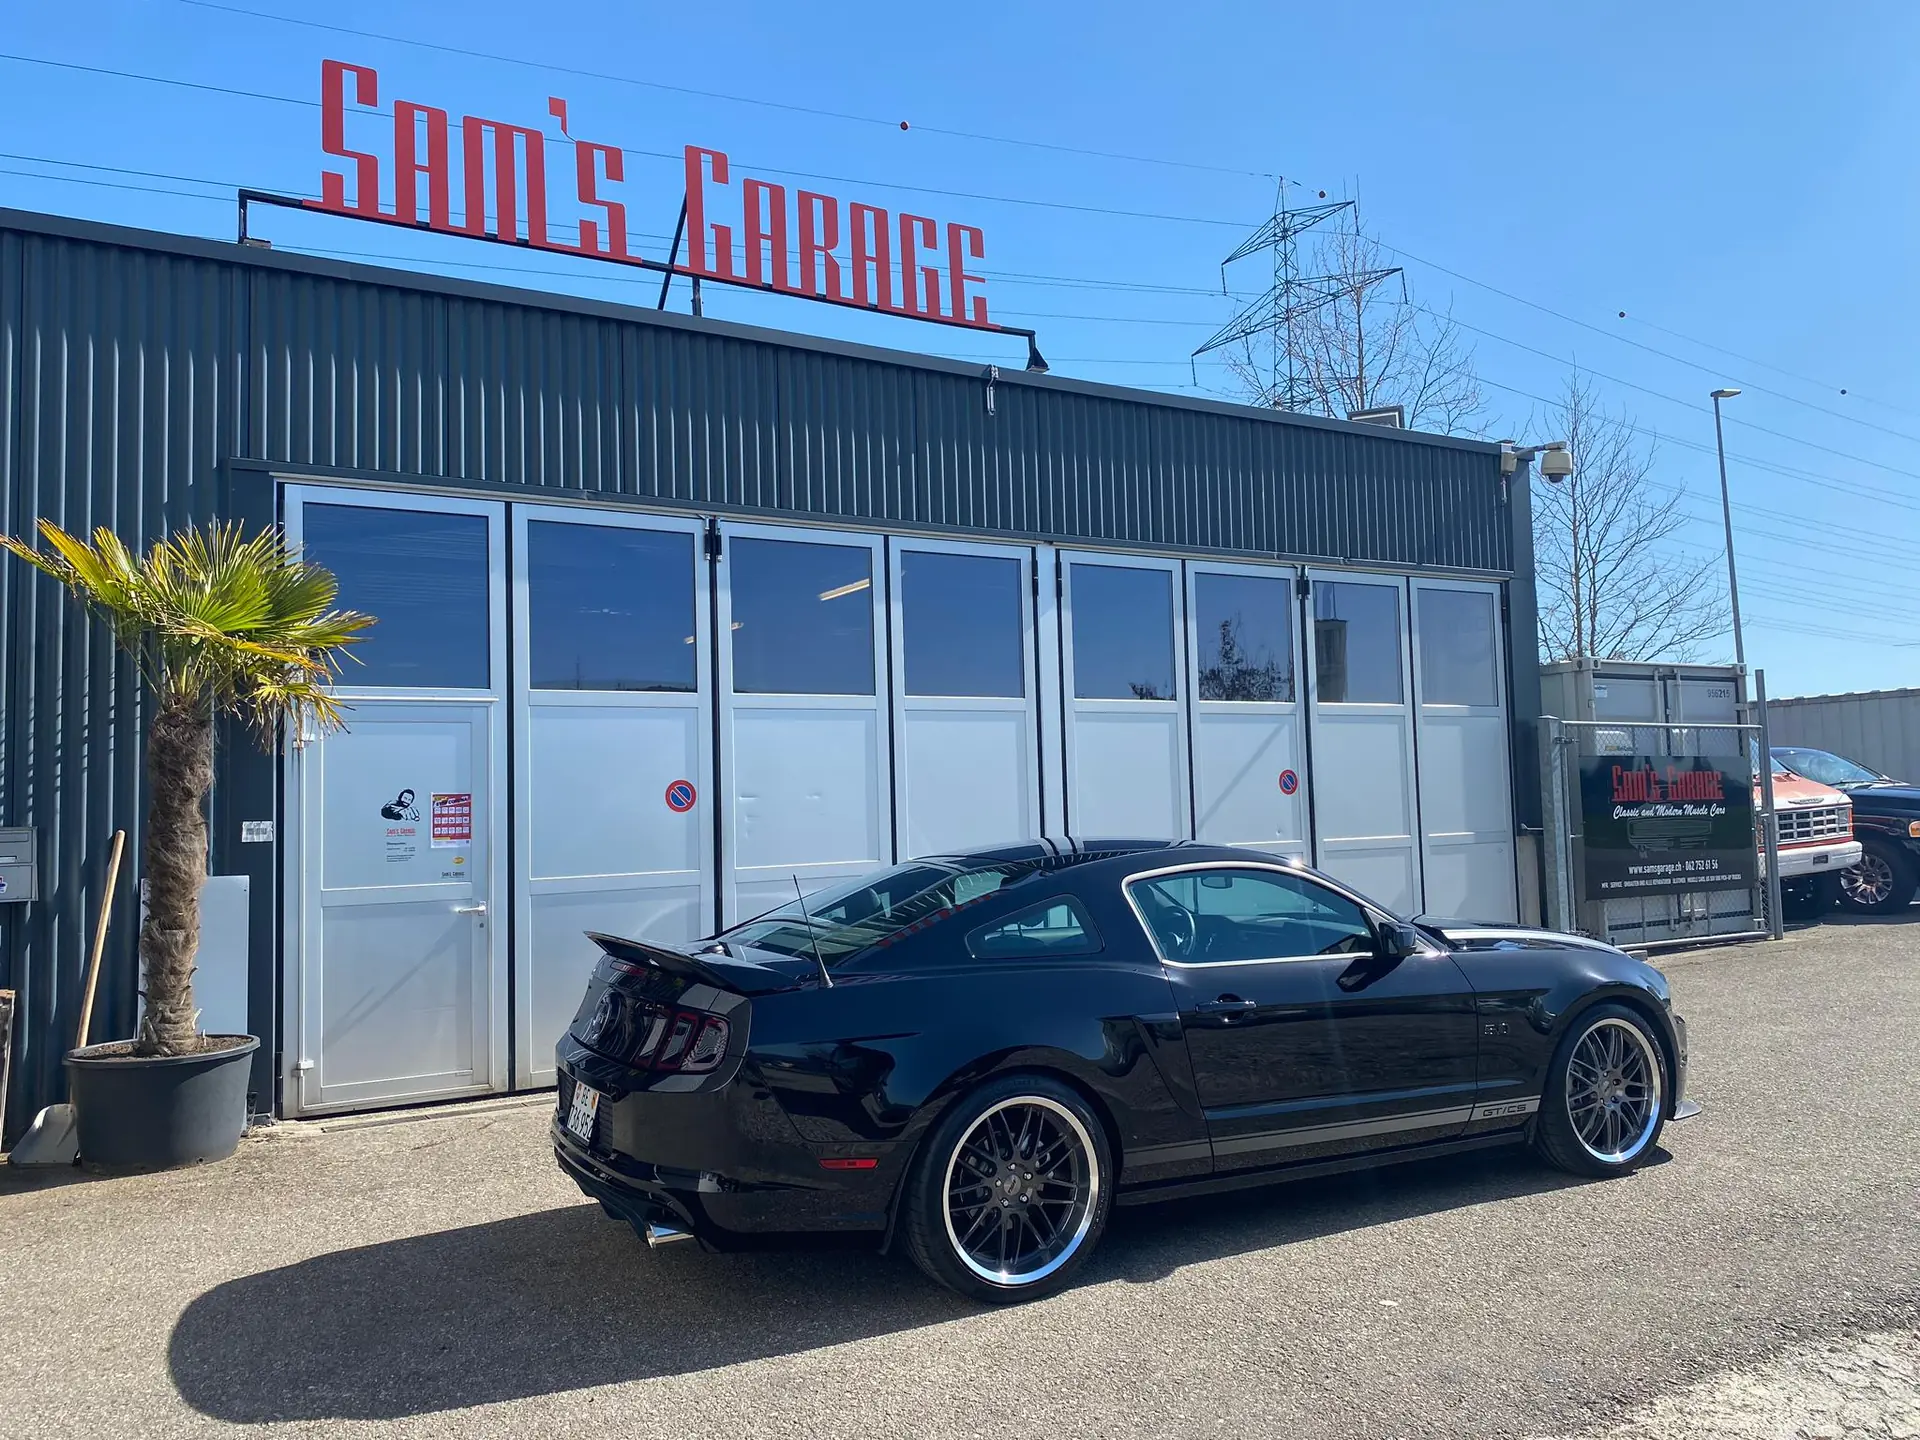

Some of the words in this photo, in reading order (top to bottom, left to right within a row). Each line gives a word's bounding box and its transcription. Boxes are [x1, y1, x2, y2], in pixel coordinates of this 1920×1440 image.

[1612, 804, 1640, 820] Classic
[1641, 805, 1655, 817] and
[1655, 803, 1683, 817] Modern
[1683, 803, 1708, 816] Muscle
[1709, 803, 1726, 817] Cars
[1628, 861, 1682, 876] www.samsgarage.ch
[1685, 860, 1695, 871] 062
[1695, 859, 1705, 871] 752
[1482, 1103, 1527, 1118] GT/CS
